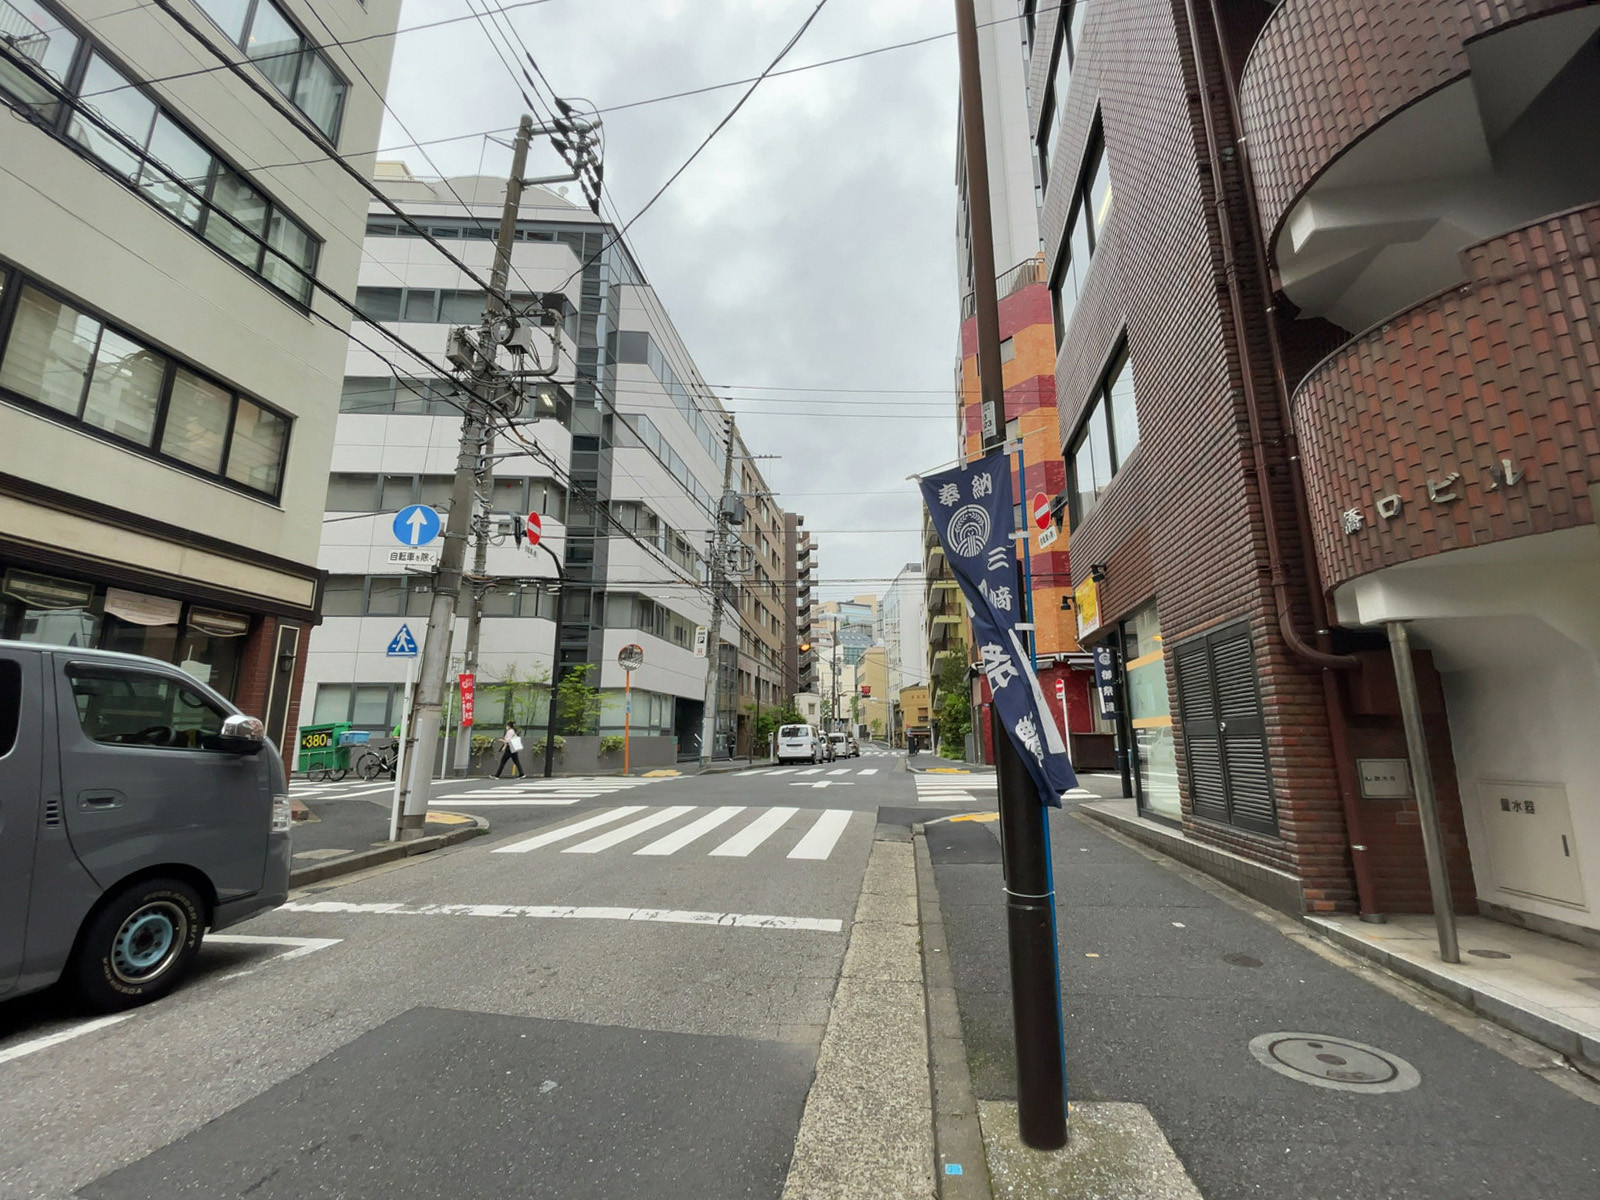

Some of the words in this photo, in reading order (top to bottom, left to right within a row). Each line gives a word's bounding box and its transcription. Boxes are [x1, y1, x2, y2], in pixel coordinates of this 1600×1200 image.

[938, 472, 992, 507] 奉納
[390, 551, 434, 562] 自転車を除く
